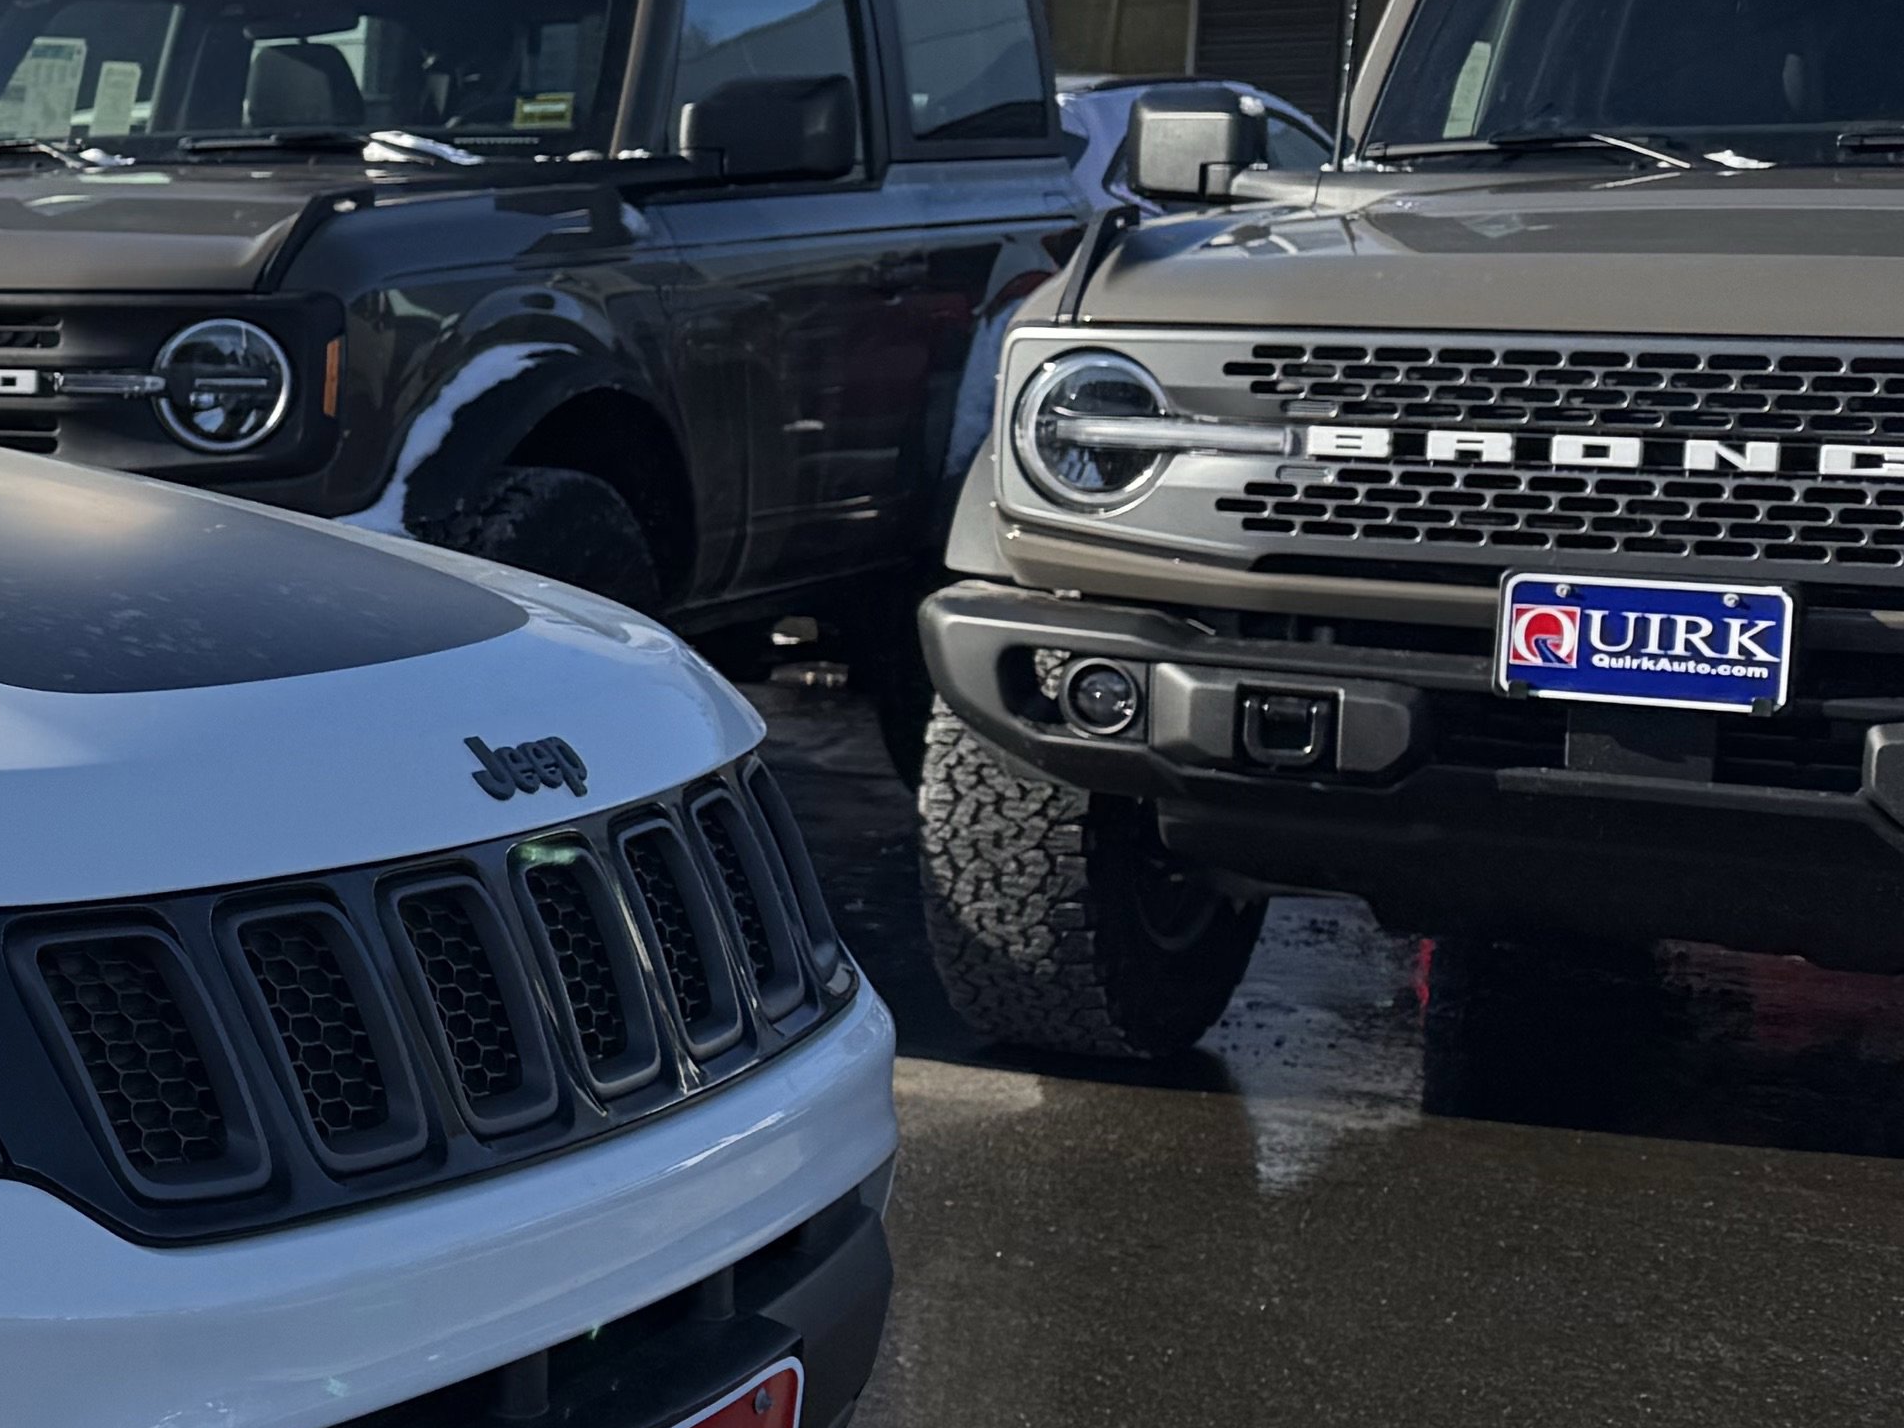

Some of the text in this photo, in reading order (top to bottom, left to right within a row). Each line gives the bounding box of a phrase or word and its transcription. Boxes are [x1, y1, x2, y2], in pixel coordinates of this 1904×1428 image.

[1513, 607, 1781, 668] QUIRK
[1592, 654, 1769, 679] QuirkAuto.com
[463, 736, 588, 801] Jeep
